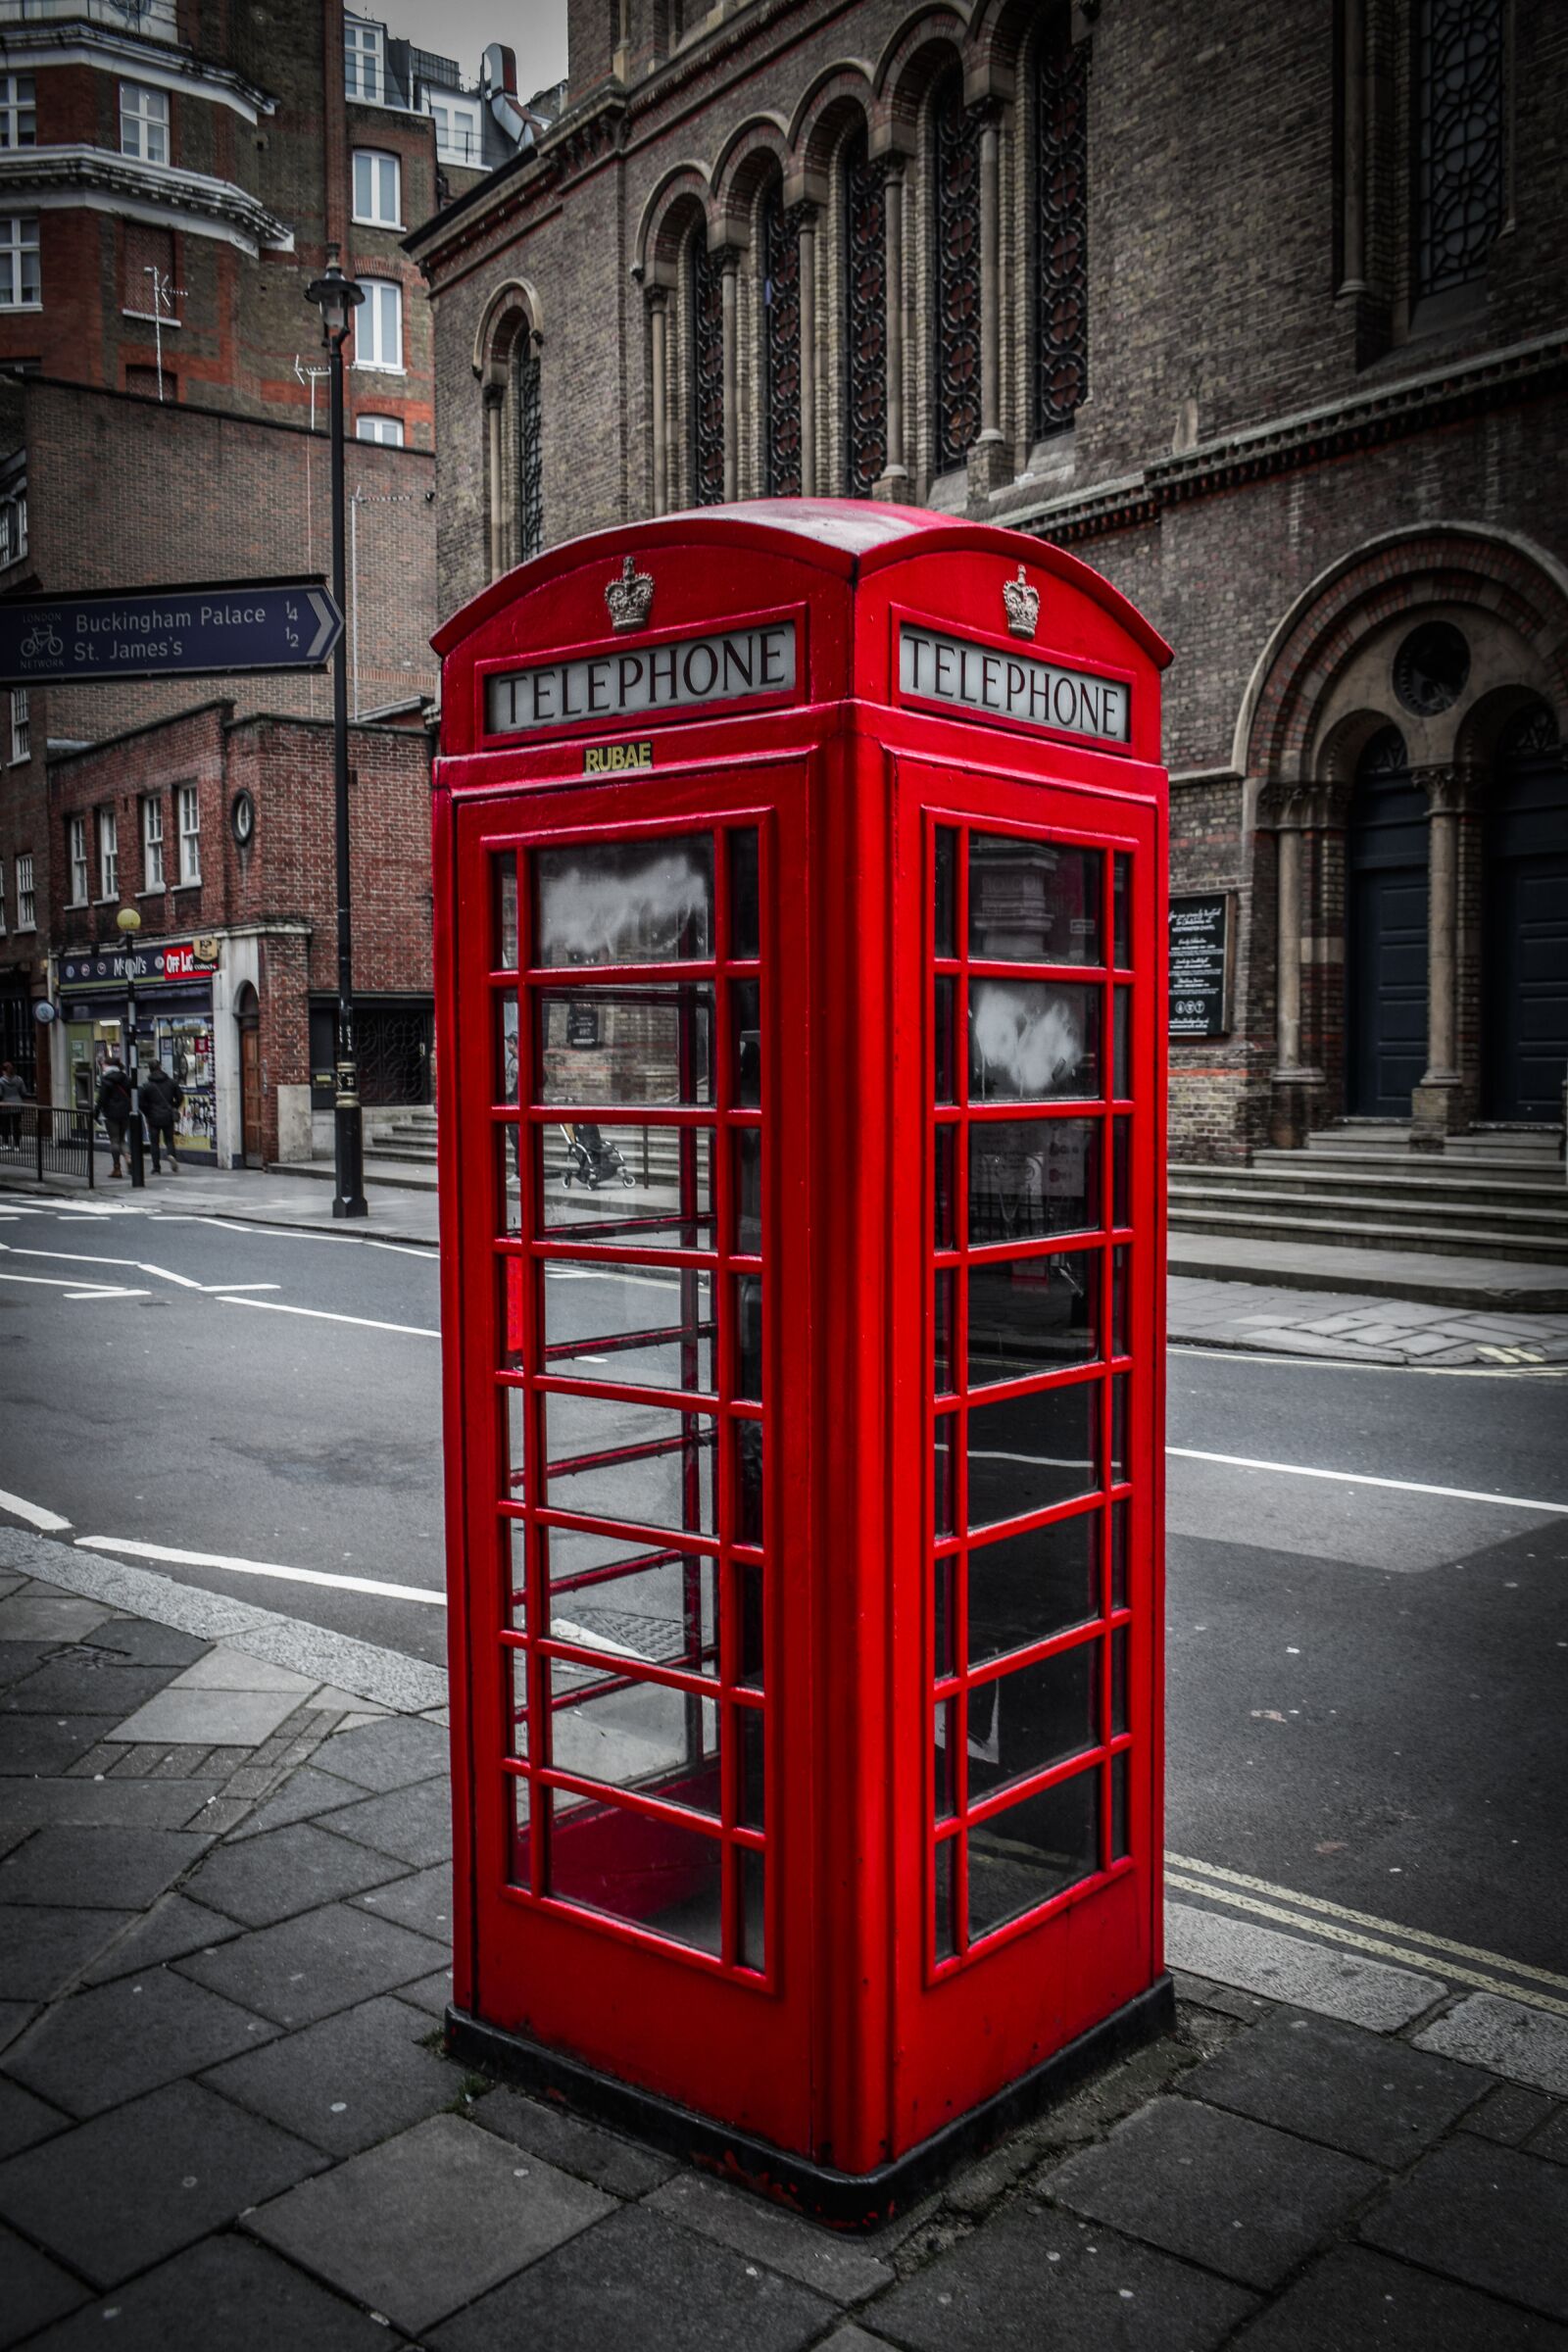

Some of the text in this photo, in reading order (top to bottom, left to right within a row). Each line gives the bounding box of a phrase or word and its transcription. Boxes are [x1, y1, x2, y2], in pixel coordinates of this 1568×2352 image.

[23, 612, 63, 624] LONDON
[75, 609, 191, 634] Buckingham
[200, 606, 267, 626] Palace
[74, 642, 100, 662] St.
[109, 637, 183, 661] James's
[20, 658, 65, 669] NETWORK
[499, 630, 787, 724] TELEPHONE
[902, 634, 1119, 736] TELEPHONE
[585, 742, 653, 772] RUBAE
[166, 954, 180, 974] OFF
